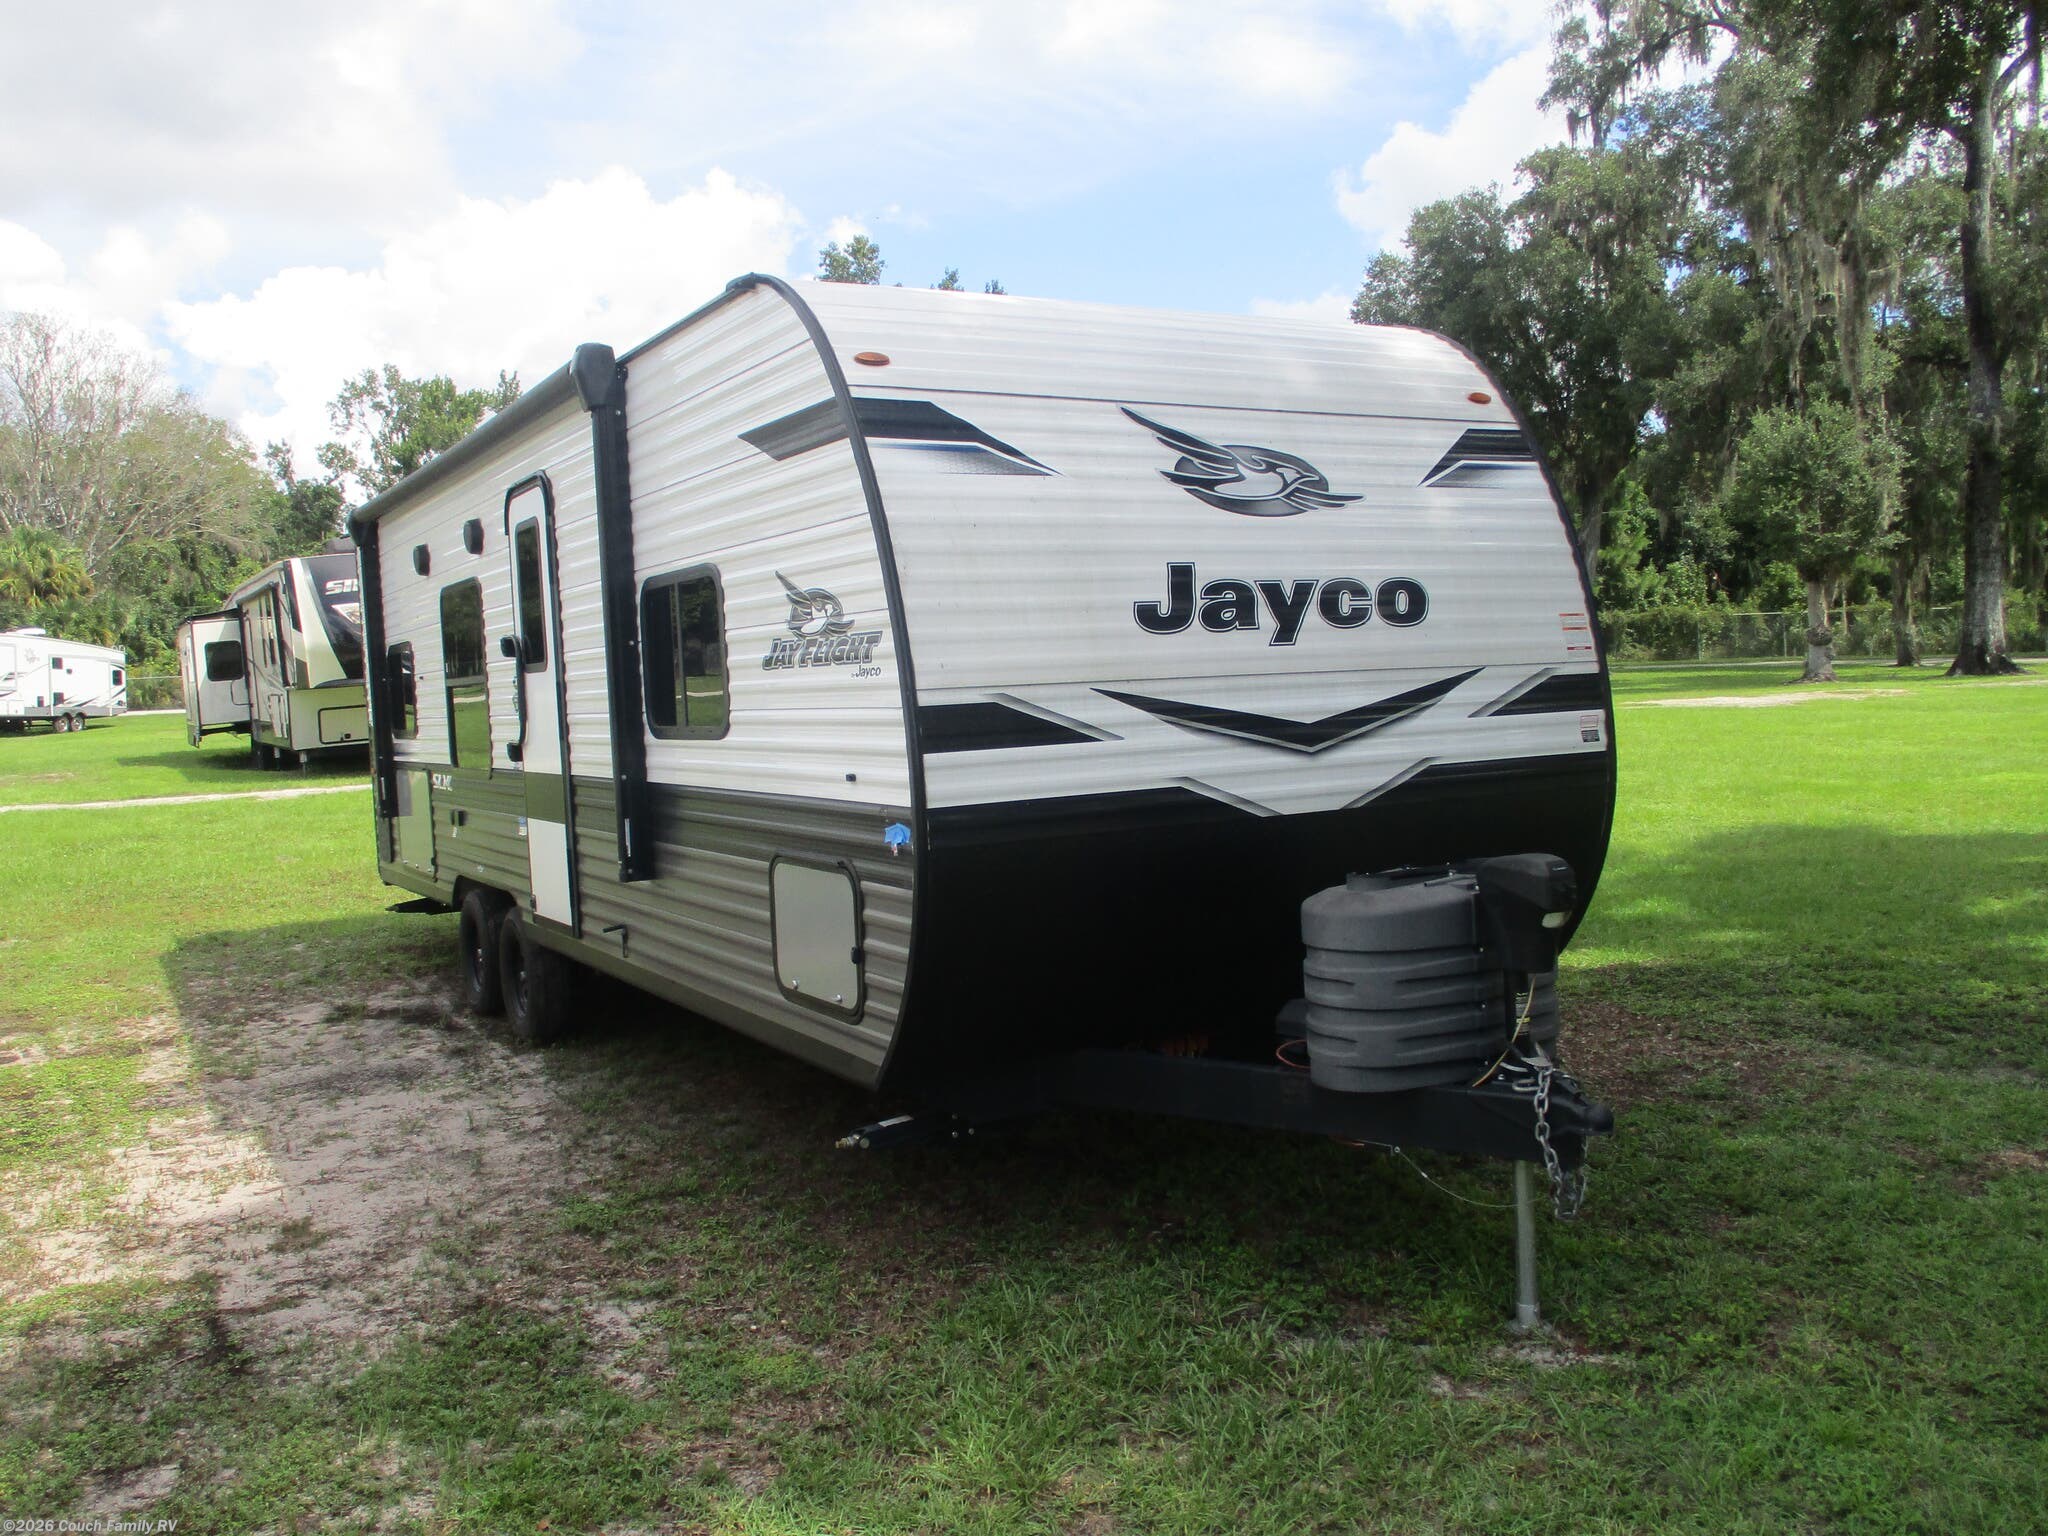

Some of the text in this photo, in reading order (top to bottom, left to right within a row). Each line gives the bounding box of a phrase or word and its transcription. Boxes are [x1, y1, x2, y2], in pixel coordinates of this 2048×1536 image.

[1133, 561, 1430, 646] Jayco
[762, 631, 883, 670] JAY FLIGHT
[855, 665, 881, 679] Jayco
